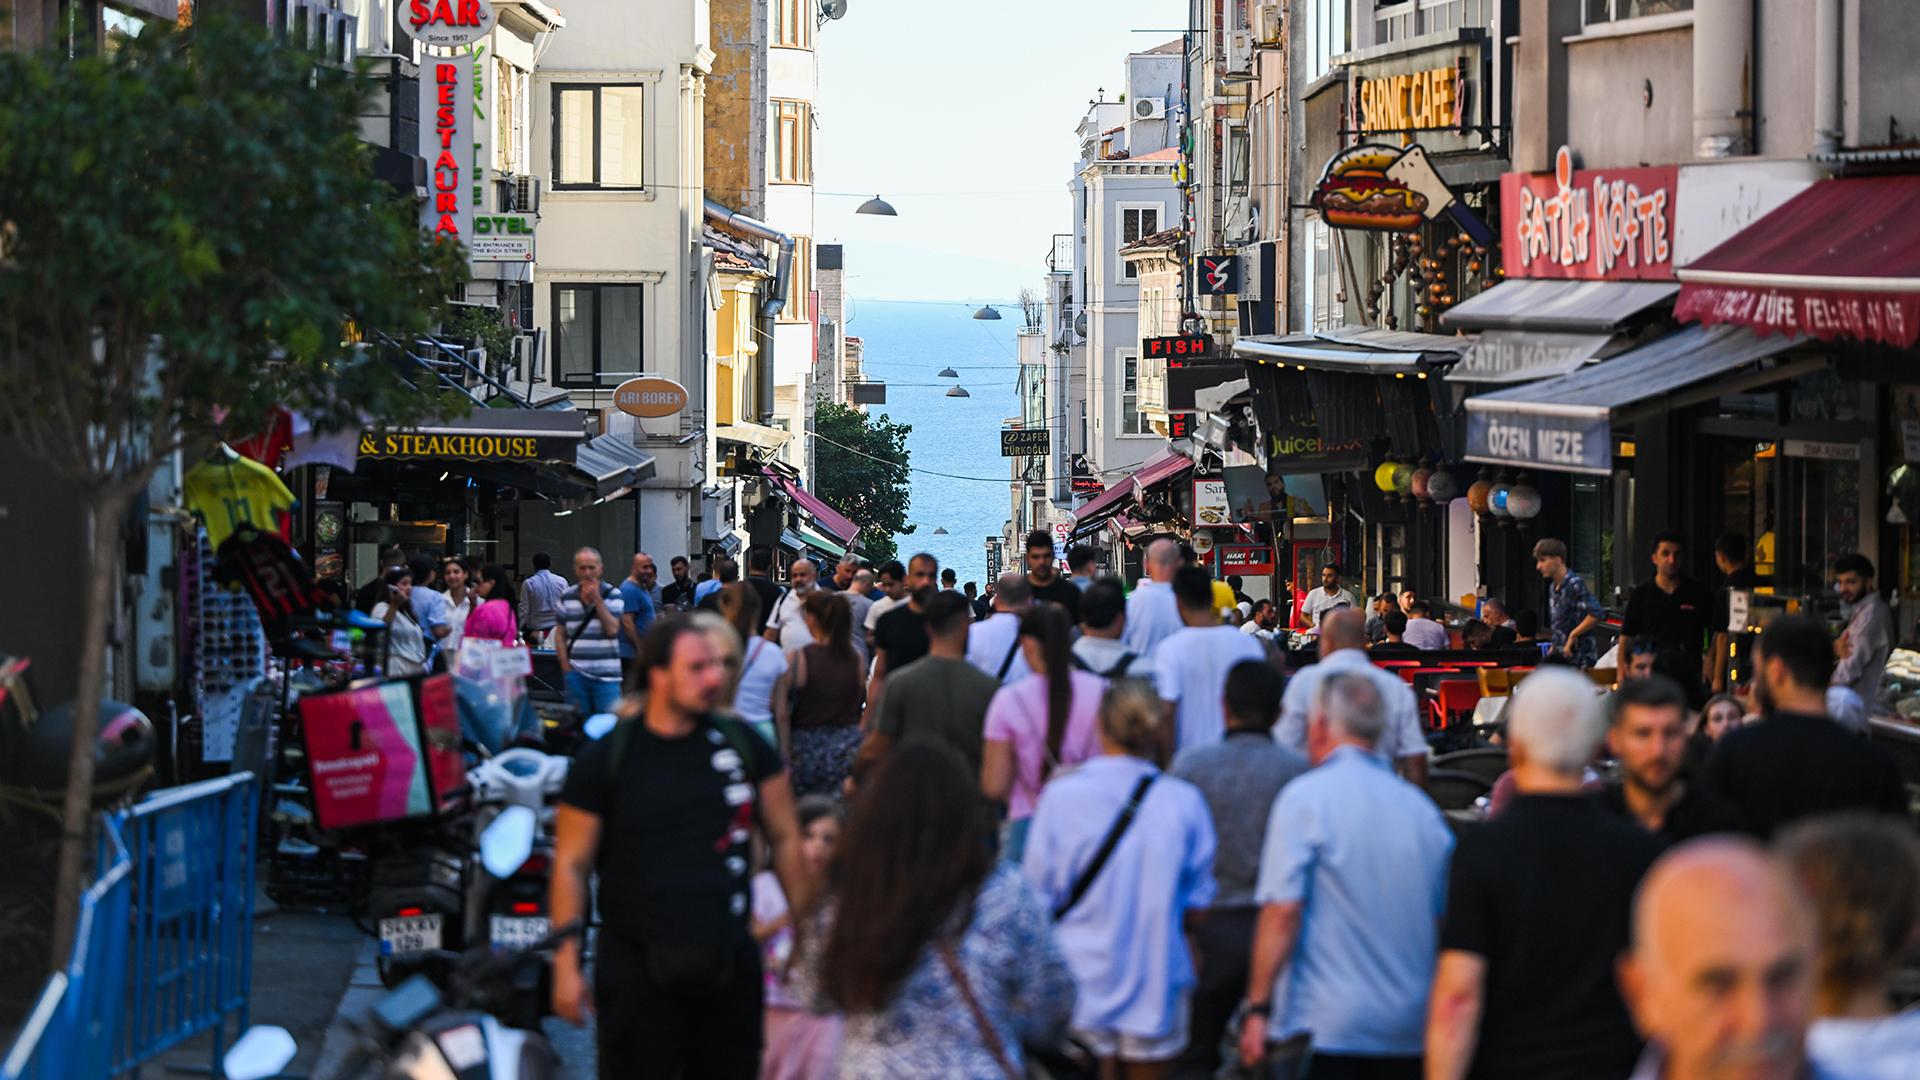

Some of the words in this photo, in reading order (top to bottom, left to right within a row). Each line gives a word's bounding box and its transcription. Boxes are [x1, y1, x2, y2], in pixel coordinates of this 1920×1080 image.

[1410, 67, 1456, 129] CAFE
[435, 63, 459, 245] RESTAURA
[472, 216, 534, 234] OTEL
[1593, 176, 1669, 275] KÖFTE
[1151, 339, 1204, 354] FISH
[1464, 339, 1516, 372] FATİH
[360, 433, 379, 454] &
[386, 434, 538, 457] STEAKHOUSE
[1003, 444, 1049, 456] TÜRKOĞLU
[1020, 432, 1048, 441] ZAFER
[1487, 419, 1531, 458] ÖZEN
[1536, 429, 1584, 464] MEZE
[1204, 483, 1226, 494] San
[987, 552, 996, 583] HOTE
